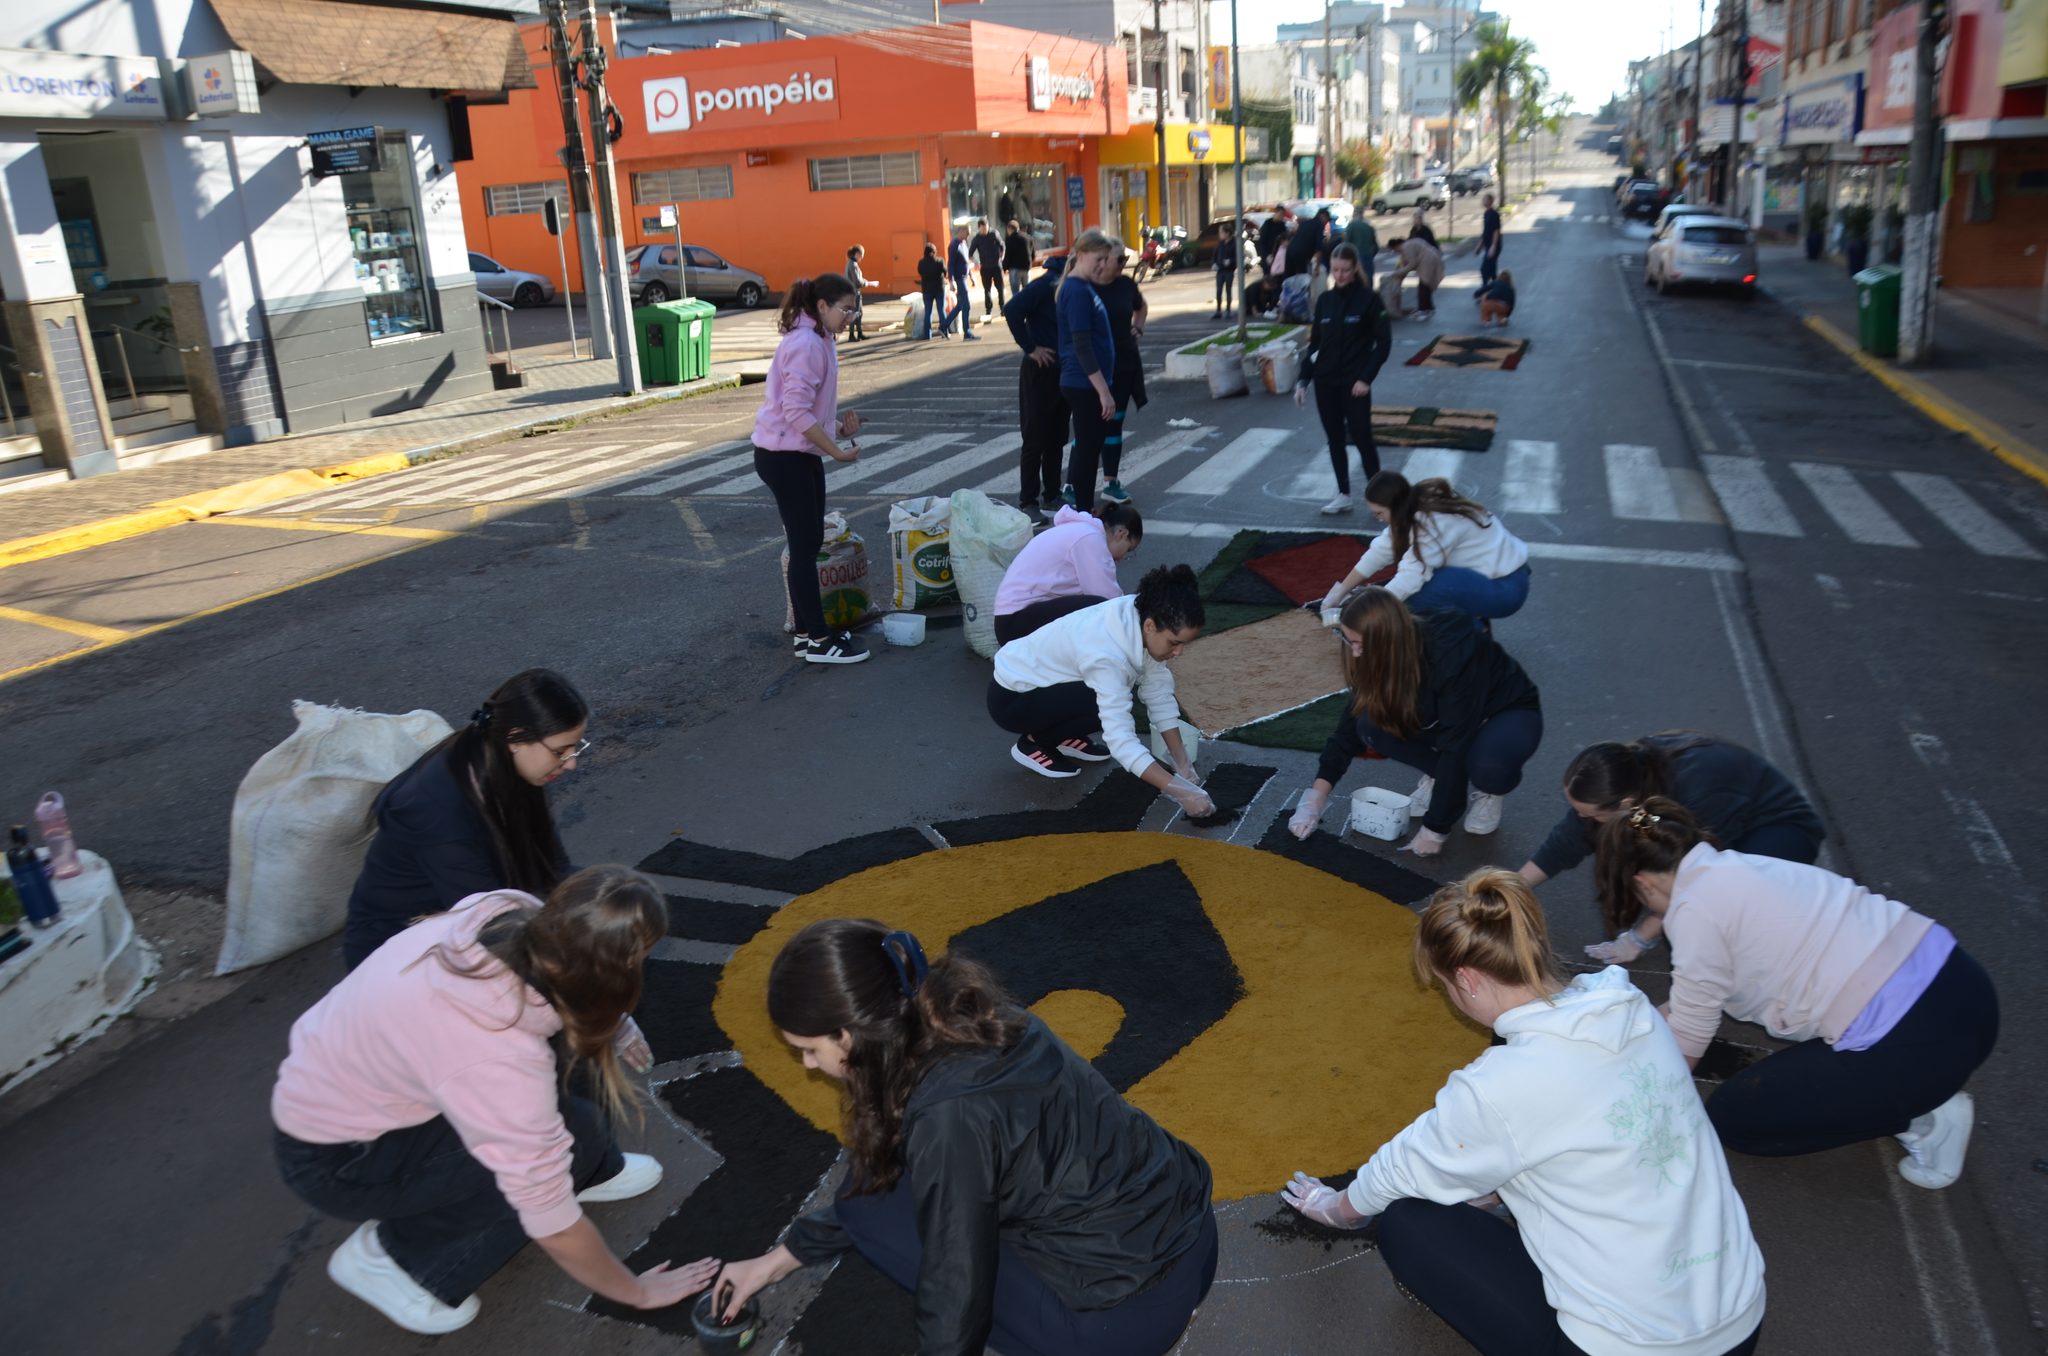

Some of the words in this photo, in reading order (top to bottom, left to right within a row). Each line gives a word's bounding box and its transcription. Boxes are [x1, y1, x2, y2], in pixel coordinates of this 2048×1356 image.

[7, 75, 117, 98] LORENZON
[125, 94, 158, 104] Loterias
[200, 91, 233, 103] Loterias
[695, 72, 834, 121] pompéia
[309, 132, 343, 145] MANIA
[343, 127, 375, 141] GAME
[918, 556, 950, 569] Cotrif
